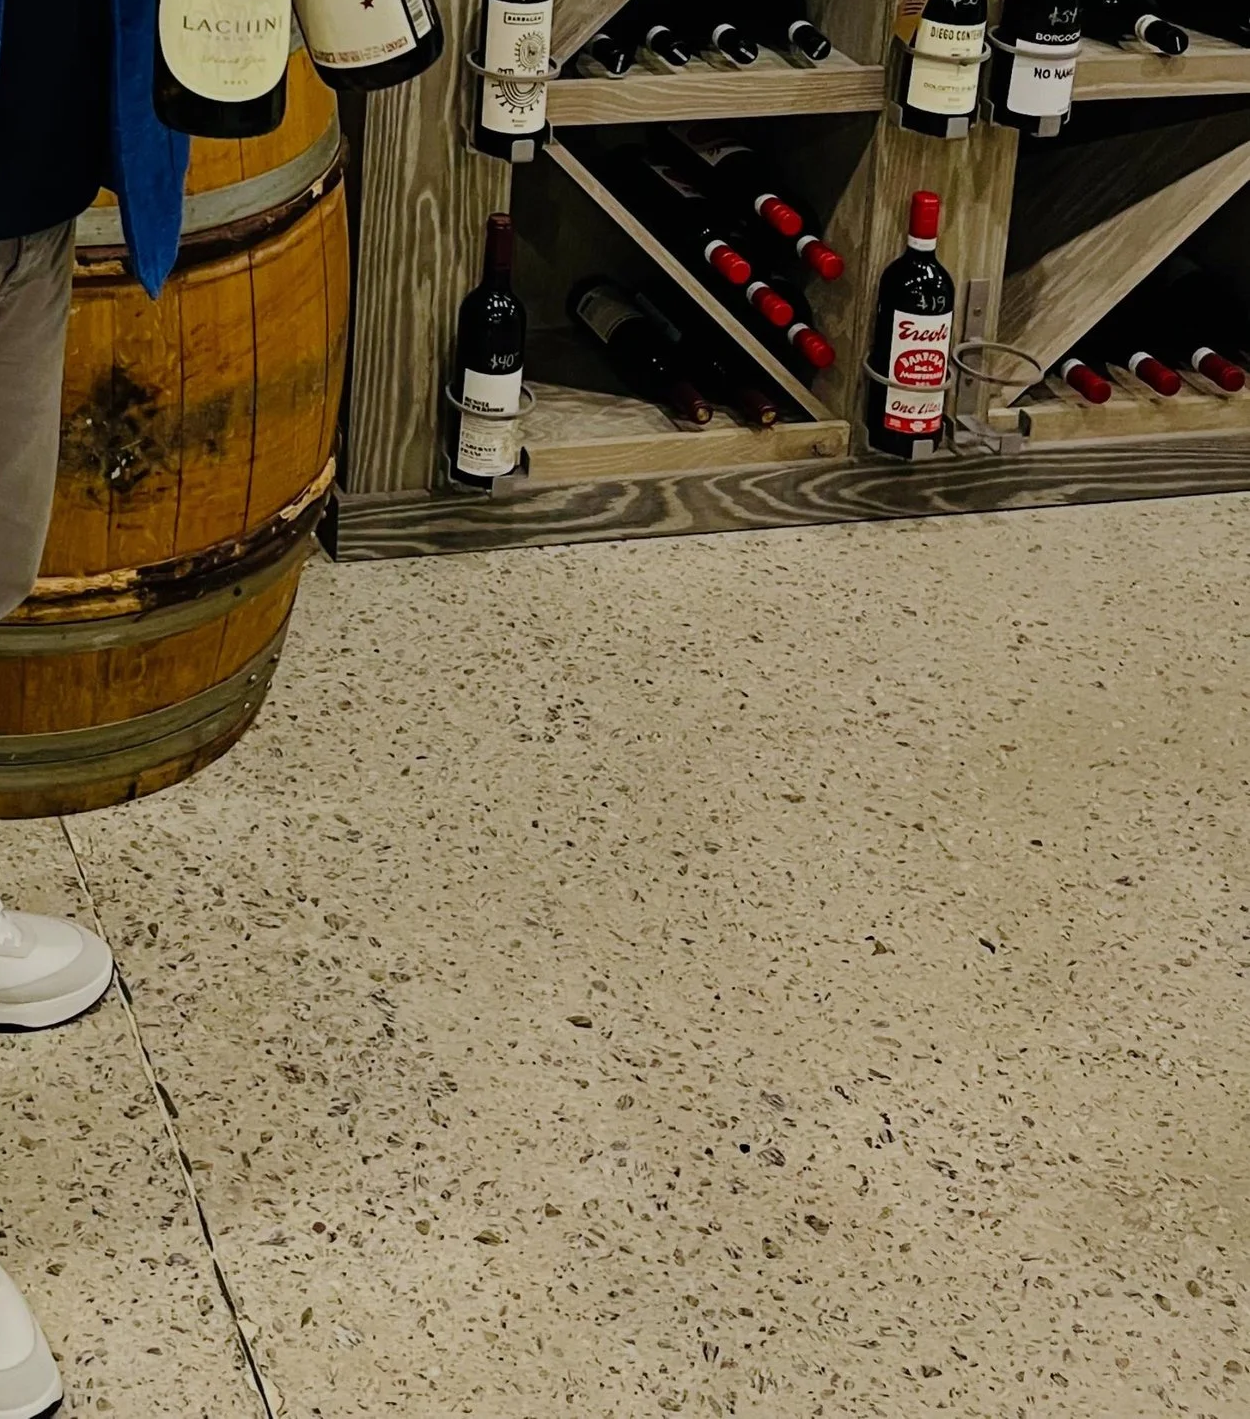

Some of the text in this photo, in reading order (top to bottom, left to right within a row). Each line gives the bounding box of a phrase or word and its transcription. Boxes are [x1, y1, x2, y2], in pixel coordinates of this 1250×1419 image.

[930, 26, 954, 40] DIEGO
[1034, 67, 1051, 79] NO
[891, 400, 915, 413] One
